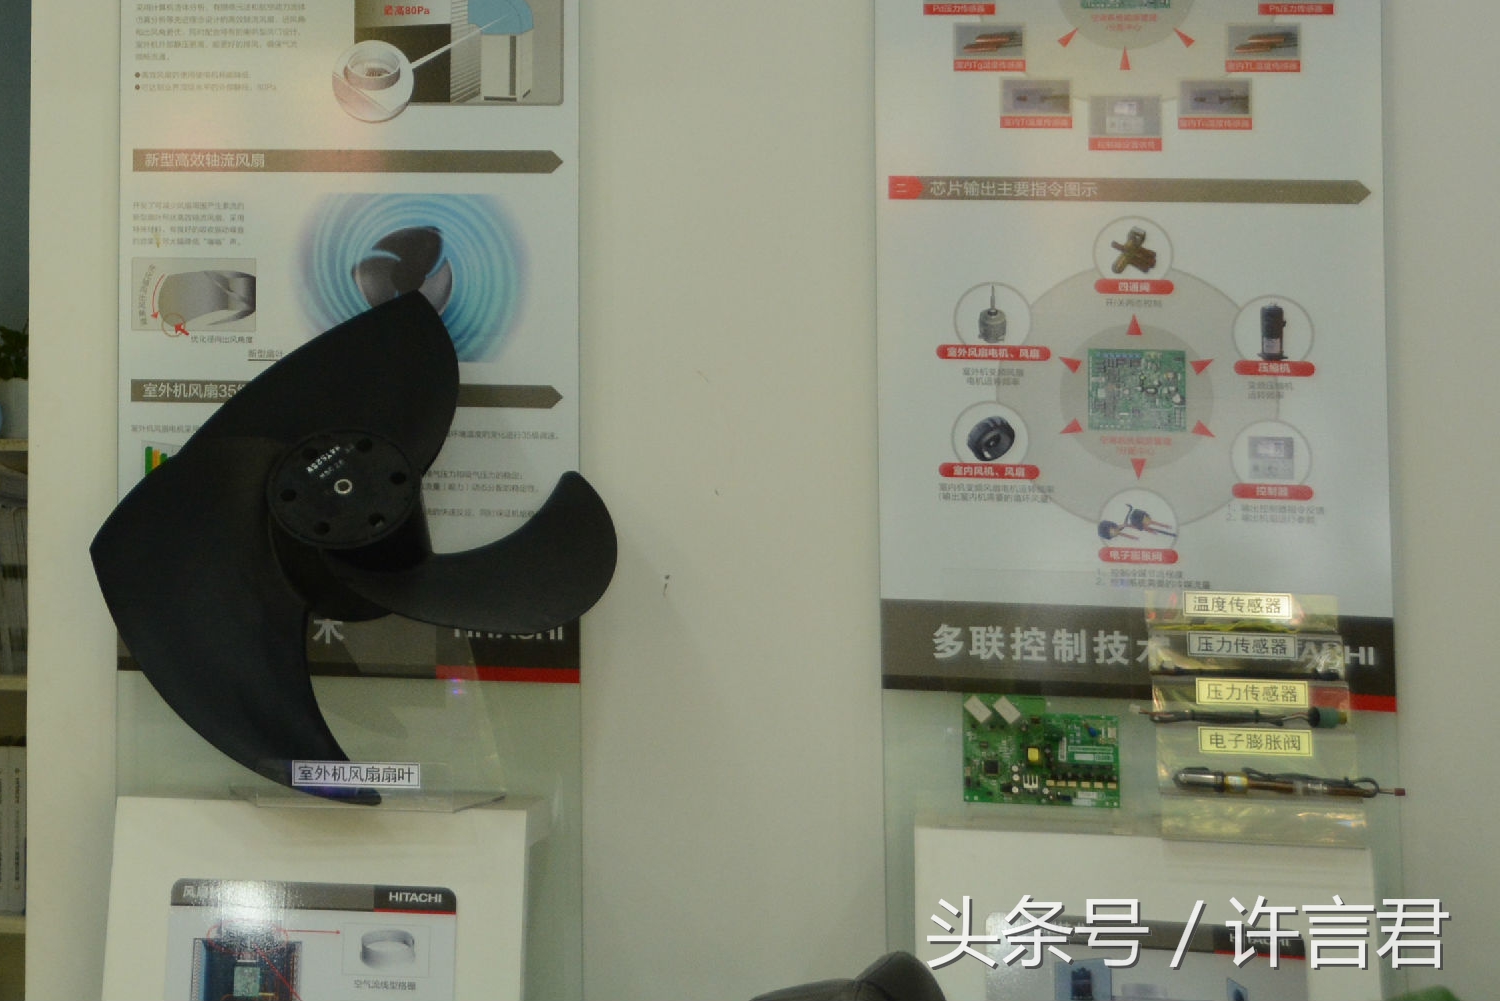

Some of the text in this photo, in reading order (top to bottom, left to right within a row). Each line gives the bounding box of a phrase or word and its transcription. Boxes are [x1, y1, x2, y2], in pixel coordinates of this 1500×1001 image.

[383, 4, 431, 16] 最高80Pa
[145, 152, 265, 168] 新型高效轴流风扇
[930, 180, 1099, 197] 芯片输出主要指令图示
[1118, 281, 1151, 294] 四通阀
[1258, 362, 1291, 375] 压缩机
[1192, 596, 1282, 614] 温度传感器
[1197, 636, 1288, 655] 压力传感器
[1206, 683, 1298, 703] 压力传感器
[1209, 731, 1301, 751] 电子膨胀阀
[297, 765, 414, 783] 室外机风扇扇叶
[388, 892, 442, 903] HITACHI
